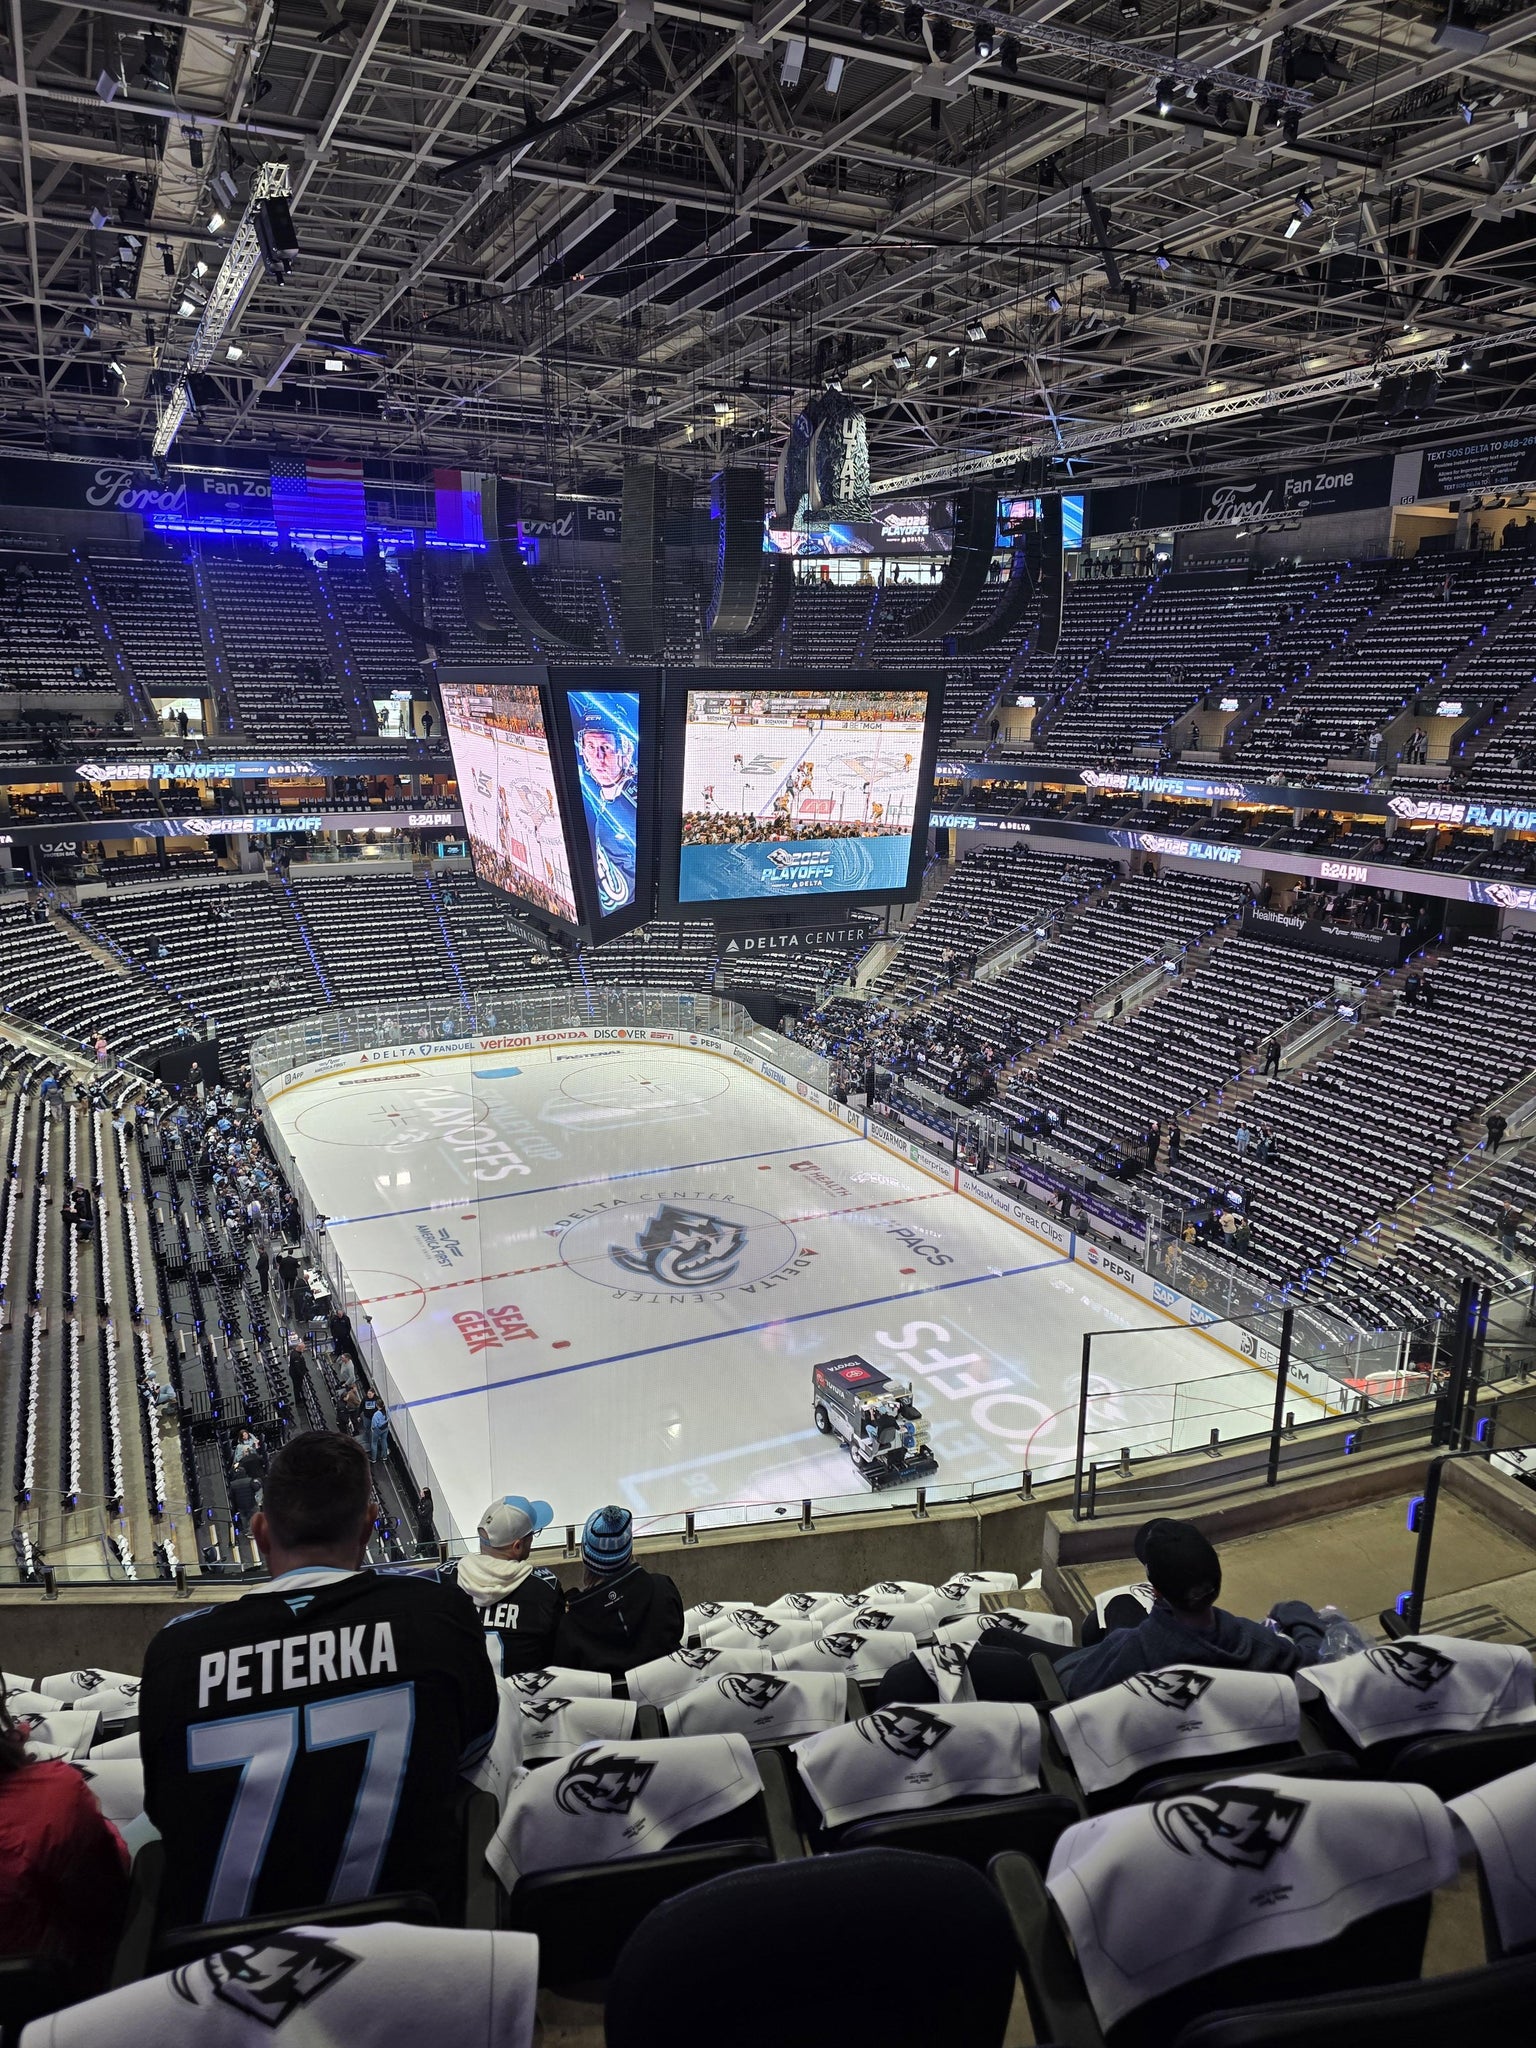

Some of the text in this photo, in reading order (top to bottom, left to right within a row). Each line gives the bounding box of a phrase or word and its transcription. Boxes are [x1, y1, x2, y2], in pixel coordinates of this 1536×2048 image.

[839, 417, 858, 501] UTAH
[1427, 451, 1446, 461] TEXT
[1446, 448, 1464, 459] SOS
[1464, 444, 1489, 456] DELTA
[1490, 441, 1502, 451] TO
[85, 467, 188, 511] Ford
[203, 478, 239, 496] Fan
[1284, 472, 1354, 496] Fan Zone
[587, 506, 616, 521] Fan
[1204, 483, 1275, 524] Ford
[881, 525, 930, 537] PLAYOFFS
[152, 762, 237, 779] PLAYOFFS
[277, 766, 310, 775] DELTA
[936, 766, 962, 775] DELTA
[1128, 775, 1185, 794] PLAYOFFS
[1214, 786, 1241, 797] DELTA
[1006, 821, 1031, 832] DELTA
[761, 864, 835, 882] PLAYOFFS
[1347, 865, 1368, 883] PM
[799, 880, 823, 888] DELTA
[1252, 908, 1306, 930] HealthEquity
[510, 923, 548, 952] DELTA CENTER
[744, 929, 865, 951] DELTA CENTER
[480, 1035, 532, 1050] verizon
[535, 1031, 589, 1042] HONDA
[594, 1029, 647, 1039] DISCOVER
[650, 1032, 674, 1040] ESPN
[700, 1038, 722, 1050] PEPSI
[373, 1048, 416, 1061] DELTA
[434, 1042, 475, 1053] FANDUEL
[733, 1046, 754, 1065] Energizer
[760, 1062, 787, 1087] FASTENAL
[828, 1099, 841, 1118] CAT
[847, 1110, 860, 1129] CAT
[871, 1124, 908, 1153] BODYARMOR
[810, 1168, 852, 1198] HEALTH
[970, 1180, 1011, 1213] MassMutual
[555, 1191, 736, 1228] DELTA CENTER
[1013, 1205, 1064, 1243] Great Clips
[416, 1224, 441, 1251] AMERICA
[433, 1248, 454, 1268] FIRST
[886, 1227, 955, 1267] PACS
[612, 1259, 812, 1304] DELTA CENTER
[1103, 1257, 1136, 1285] PEPSI
[1153, 1284, 1176, 1305] SAP
[451, 1310, 504, 1355] GEEK
[486, 1304, 540, 1342] SEAT
[826, 1361, 862, 1372] TOYOTA
[1259, 1347, 1310, 1384] BETGM
[826, 1379, 846, 1400] TOYOTA
[198, 1621, 398, 1709] PETERKA
[187, 1680, 416, 1924] 77
